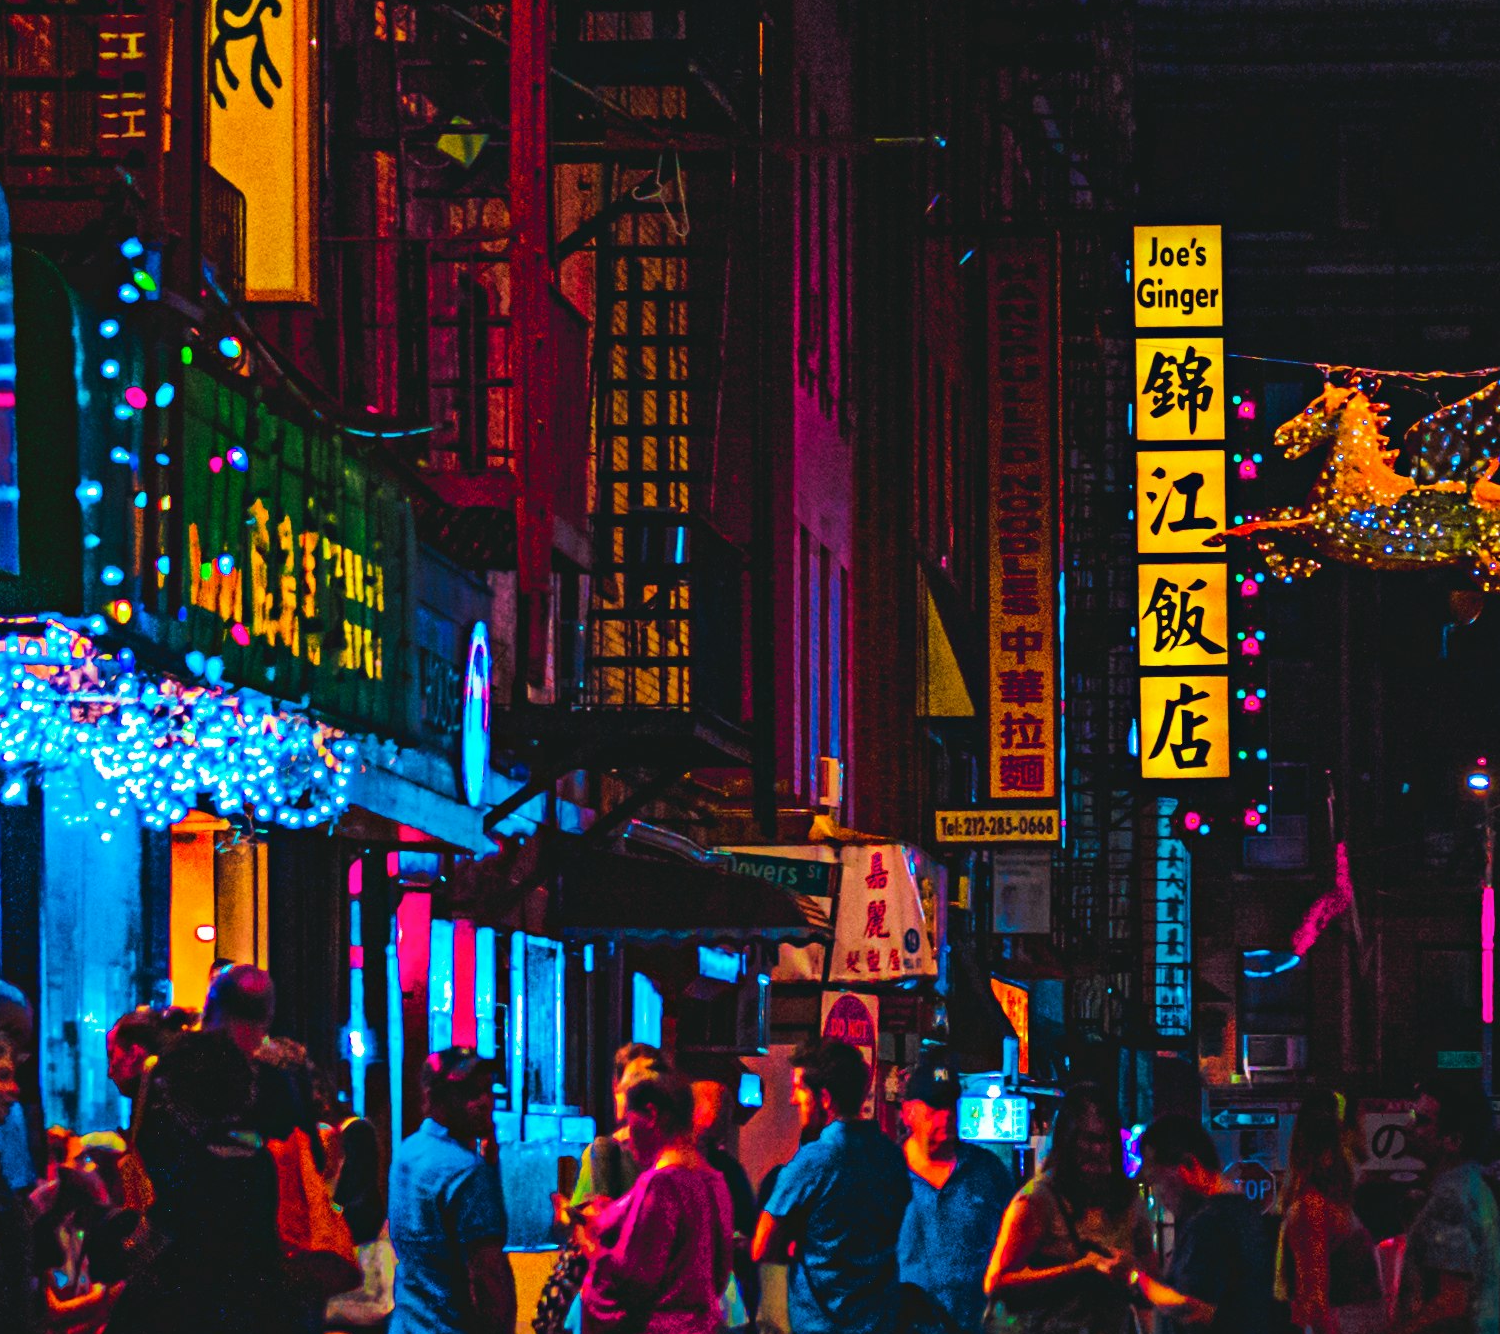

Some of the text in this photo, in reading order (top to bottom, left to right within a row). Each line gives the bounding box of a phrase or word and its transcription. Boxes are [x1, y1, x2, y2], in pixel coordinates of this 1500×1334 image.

[1148, 236, 1207, 267] Joe's
[1135, 279, 1219, 316] Ginger
[1140, 347, 1227, 770] 錦江飯店
